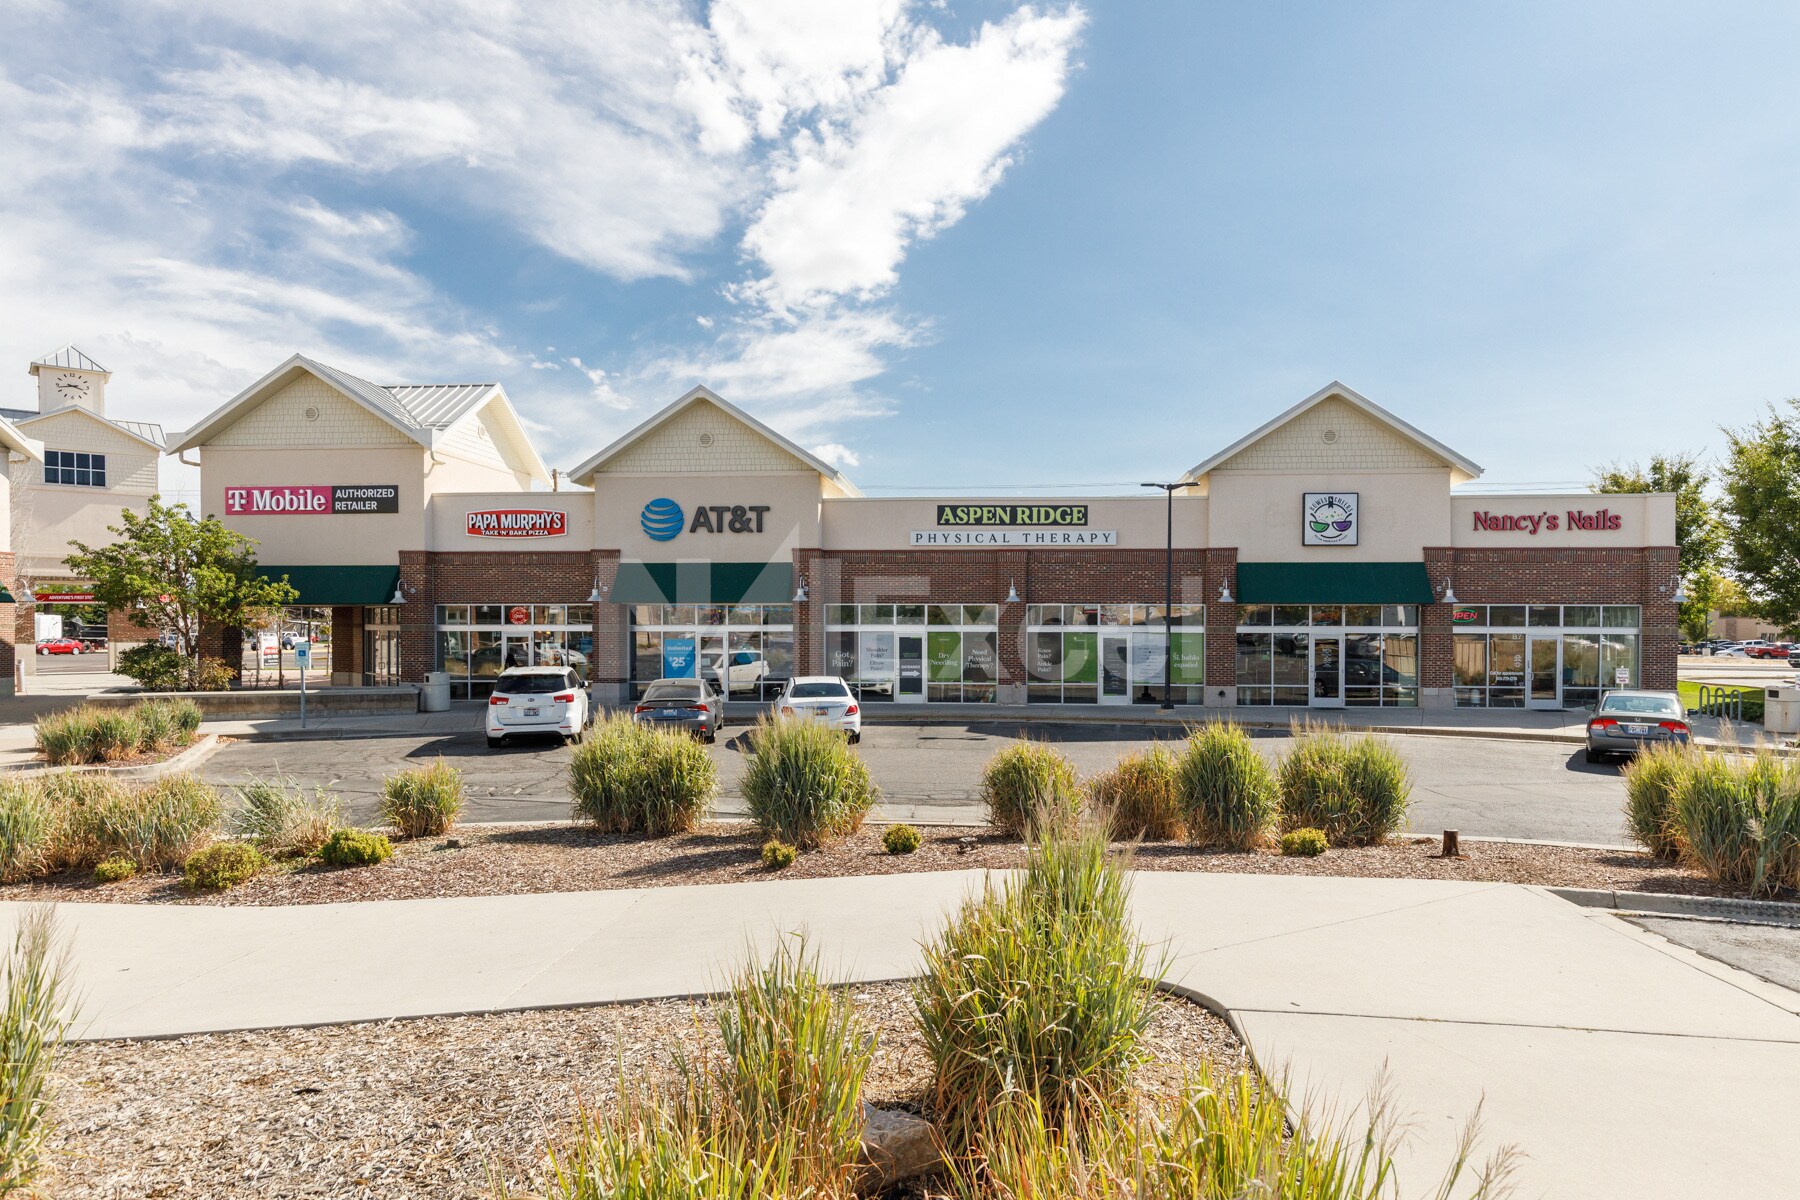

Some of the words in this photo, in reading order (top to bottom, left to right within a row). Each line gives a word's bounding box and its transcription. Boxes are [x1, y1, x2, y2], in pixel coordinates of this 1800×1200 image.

[335, 488, 395, 498] AUTHORIZED
[251, 488, 327, 511] Mobile
[335, 501, 378, 511] RETAILER
[689, 505, 771, 534] AT&T
[940, 506, 1011, 524] ASPEN
[1016, 506, 1085, 524] RIDGE
[469, 513, 499, 530] PAPA
[500, 511, 562, 530] MURPHY'S
[1473, 511, 1560, 535] Nancy's
[1566, 508, 1622, 531] Nails
[915, 533, 1010, 543] PHYSICAL
[1022, 533, 1112, 543] THERAPY
[835, 650, 850, 658] Got
[938, 652, 950, 660] Dry
[832, 659, 854, 667] Pain?
[931, 659, 959, 667] Needling
[966, 662, 994, 670] Therapy?
